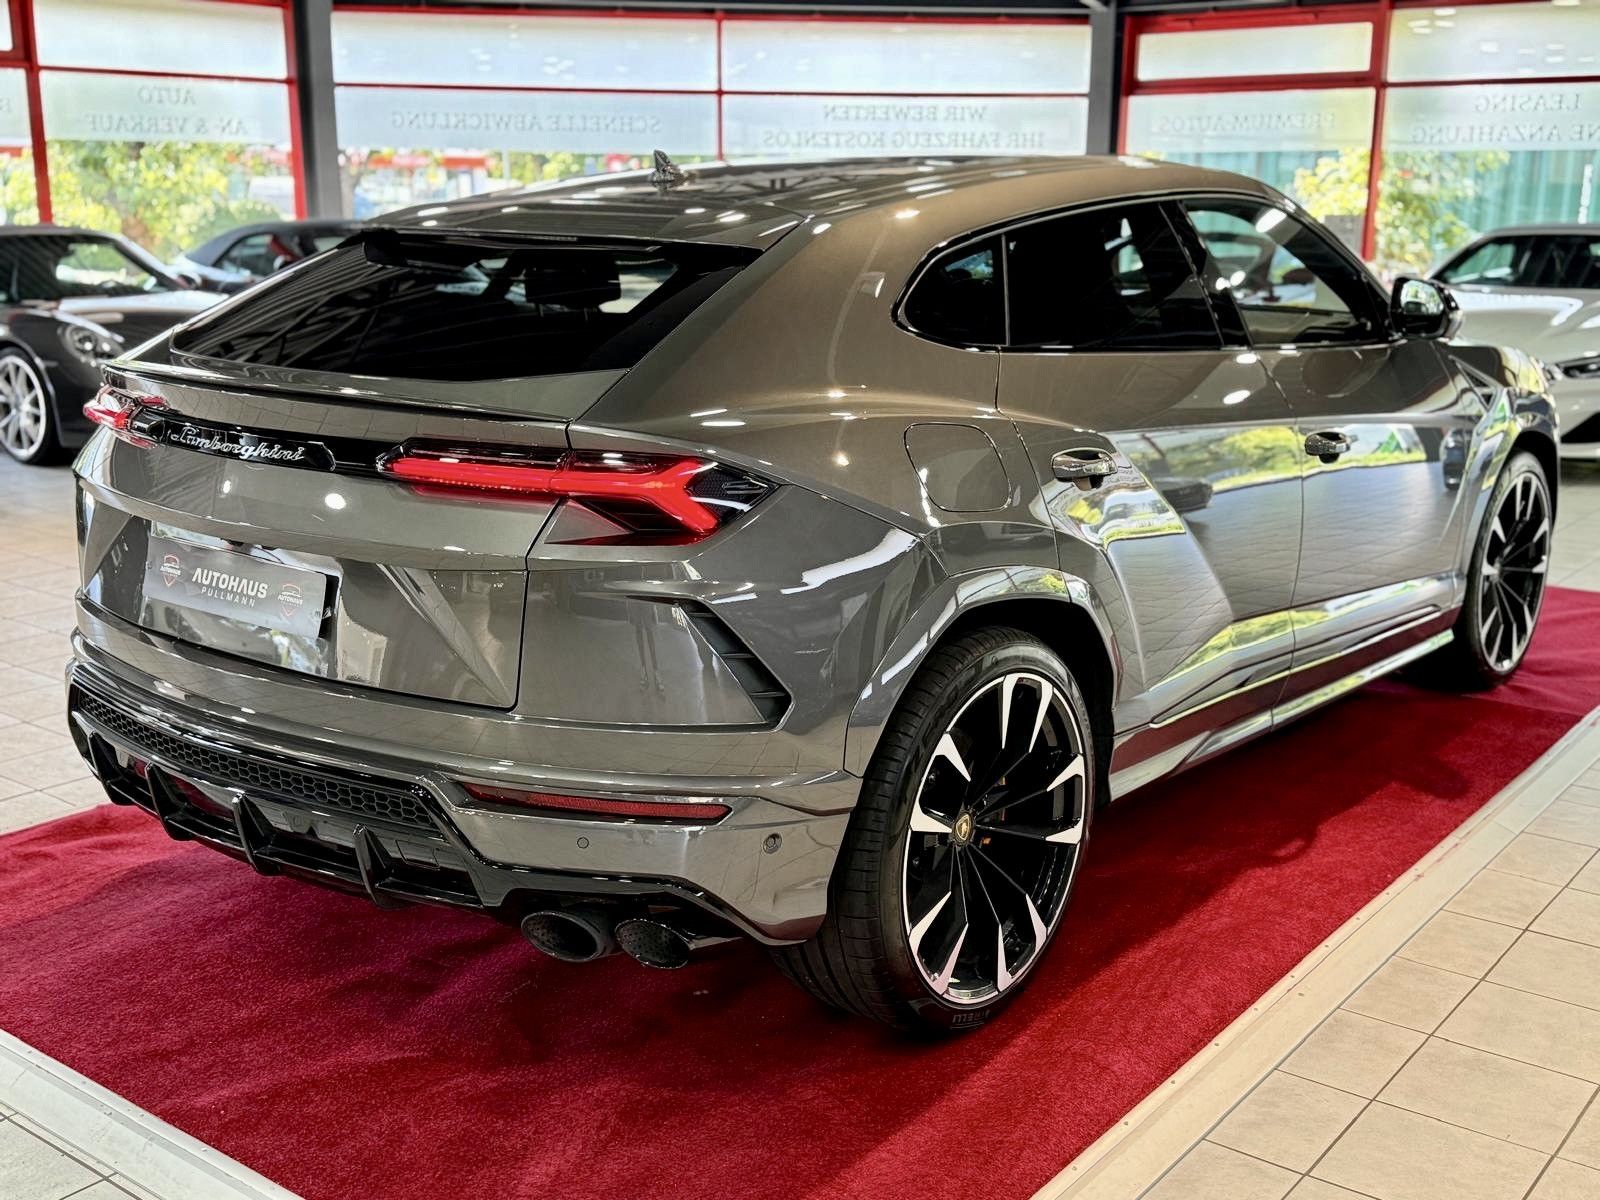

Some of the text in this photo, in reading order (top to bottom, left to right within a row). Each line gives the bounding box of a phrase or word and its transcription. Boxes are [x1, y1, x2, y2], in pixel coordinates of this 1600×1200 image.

[170, 426, 305, 460] Lamborghini
[192, 567, 269, 599] AUTOHAUS
[201, 586, 256, 608] PULLMANN
